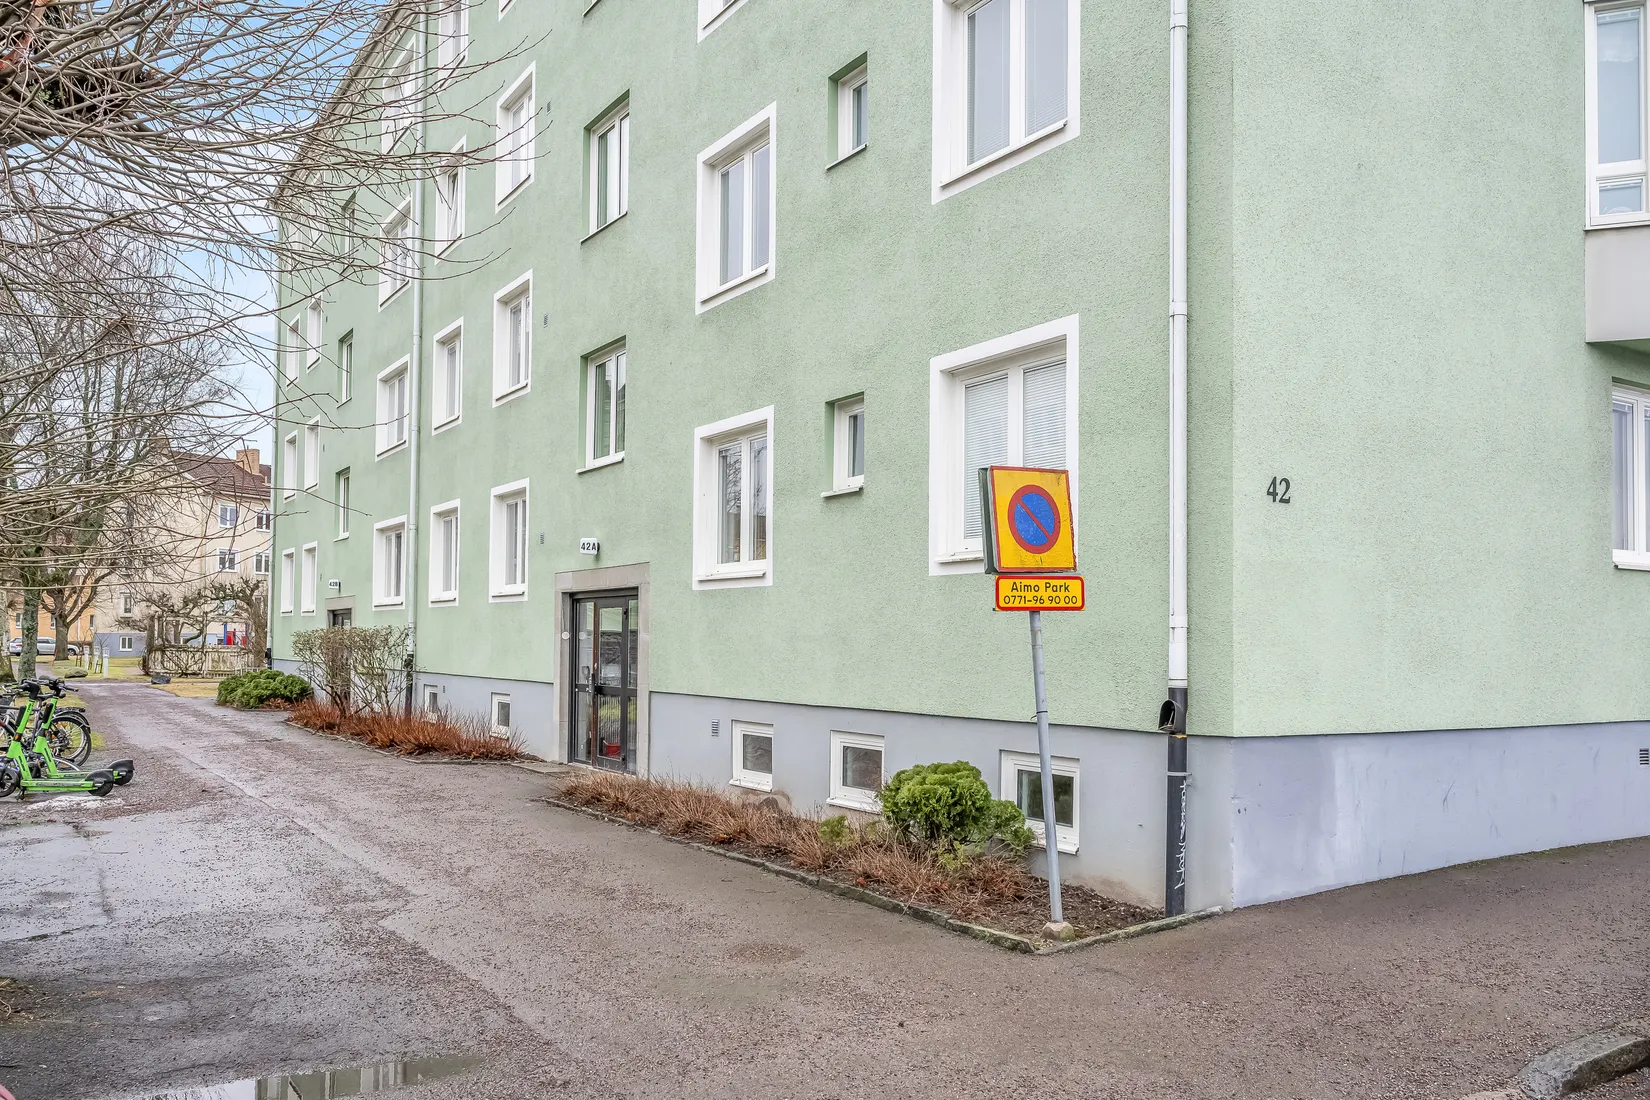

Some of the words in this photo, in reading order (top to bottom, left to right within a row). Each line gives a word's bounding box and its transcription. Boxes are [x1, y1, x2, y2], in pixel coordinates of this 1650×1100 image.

[1266, 476, 1291, 504] 42
[580, 542, 597, 551] 42A
[1010, 581, 1040, 593] Aimo
[1044, 581, 1071, 593] Park
[1003, 595, 1045, 605] 0771-96
[1047, 595, 1061, 605] 90
[1063, 595, 1078, 605] 00
